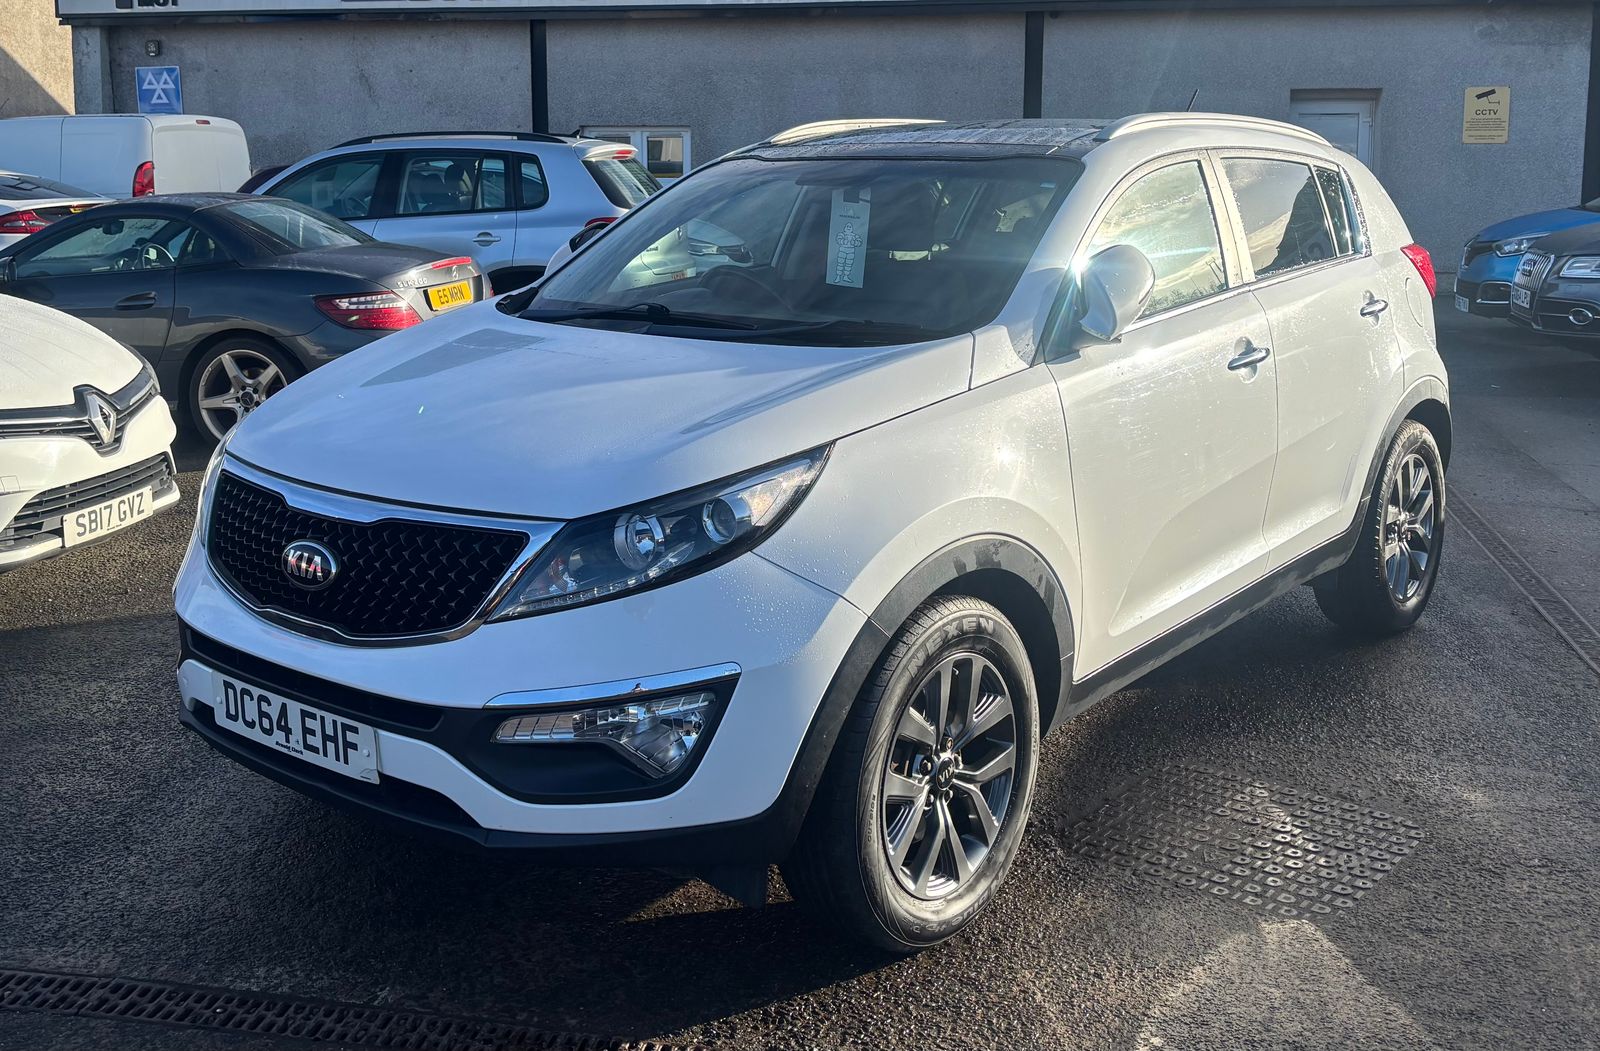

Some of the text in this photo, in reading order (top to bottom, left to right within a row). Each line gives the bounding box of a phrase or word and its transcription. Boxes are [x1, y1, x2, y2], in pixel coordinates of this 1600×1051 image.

[436, 284, 465, 304] E5 MRN
[75, 492, 145, 538] SB17 GVZ
[287, 549, 324, 582] KIA
[907, 617, 995, 679] NEXEN
[222, 679, 360, 766] DC64 EHF
[938, 763, 954, 783] KIA
